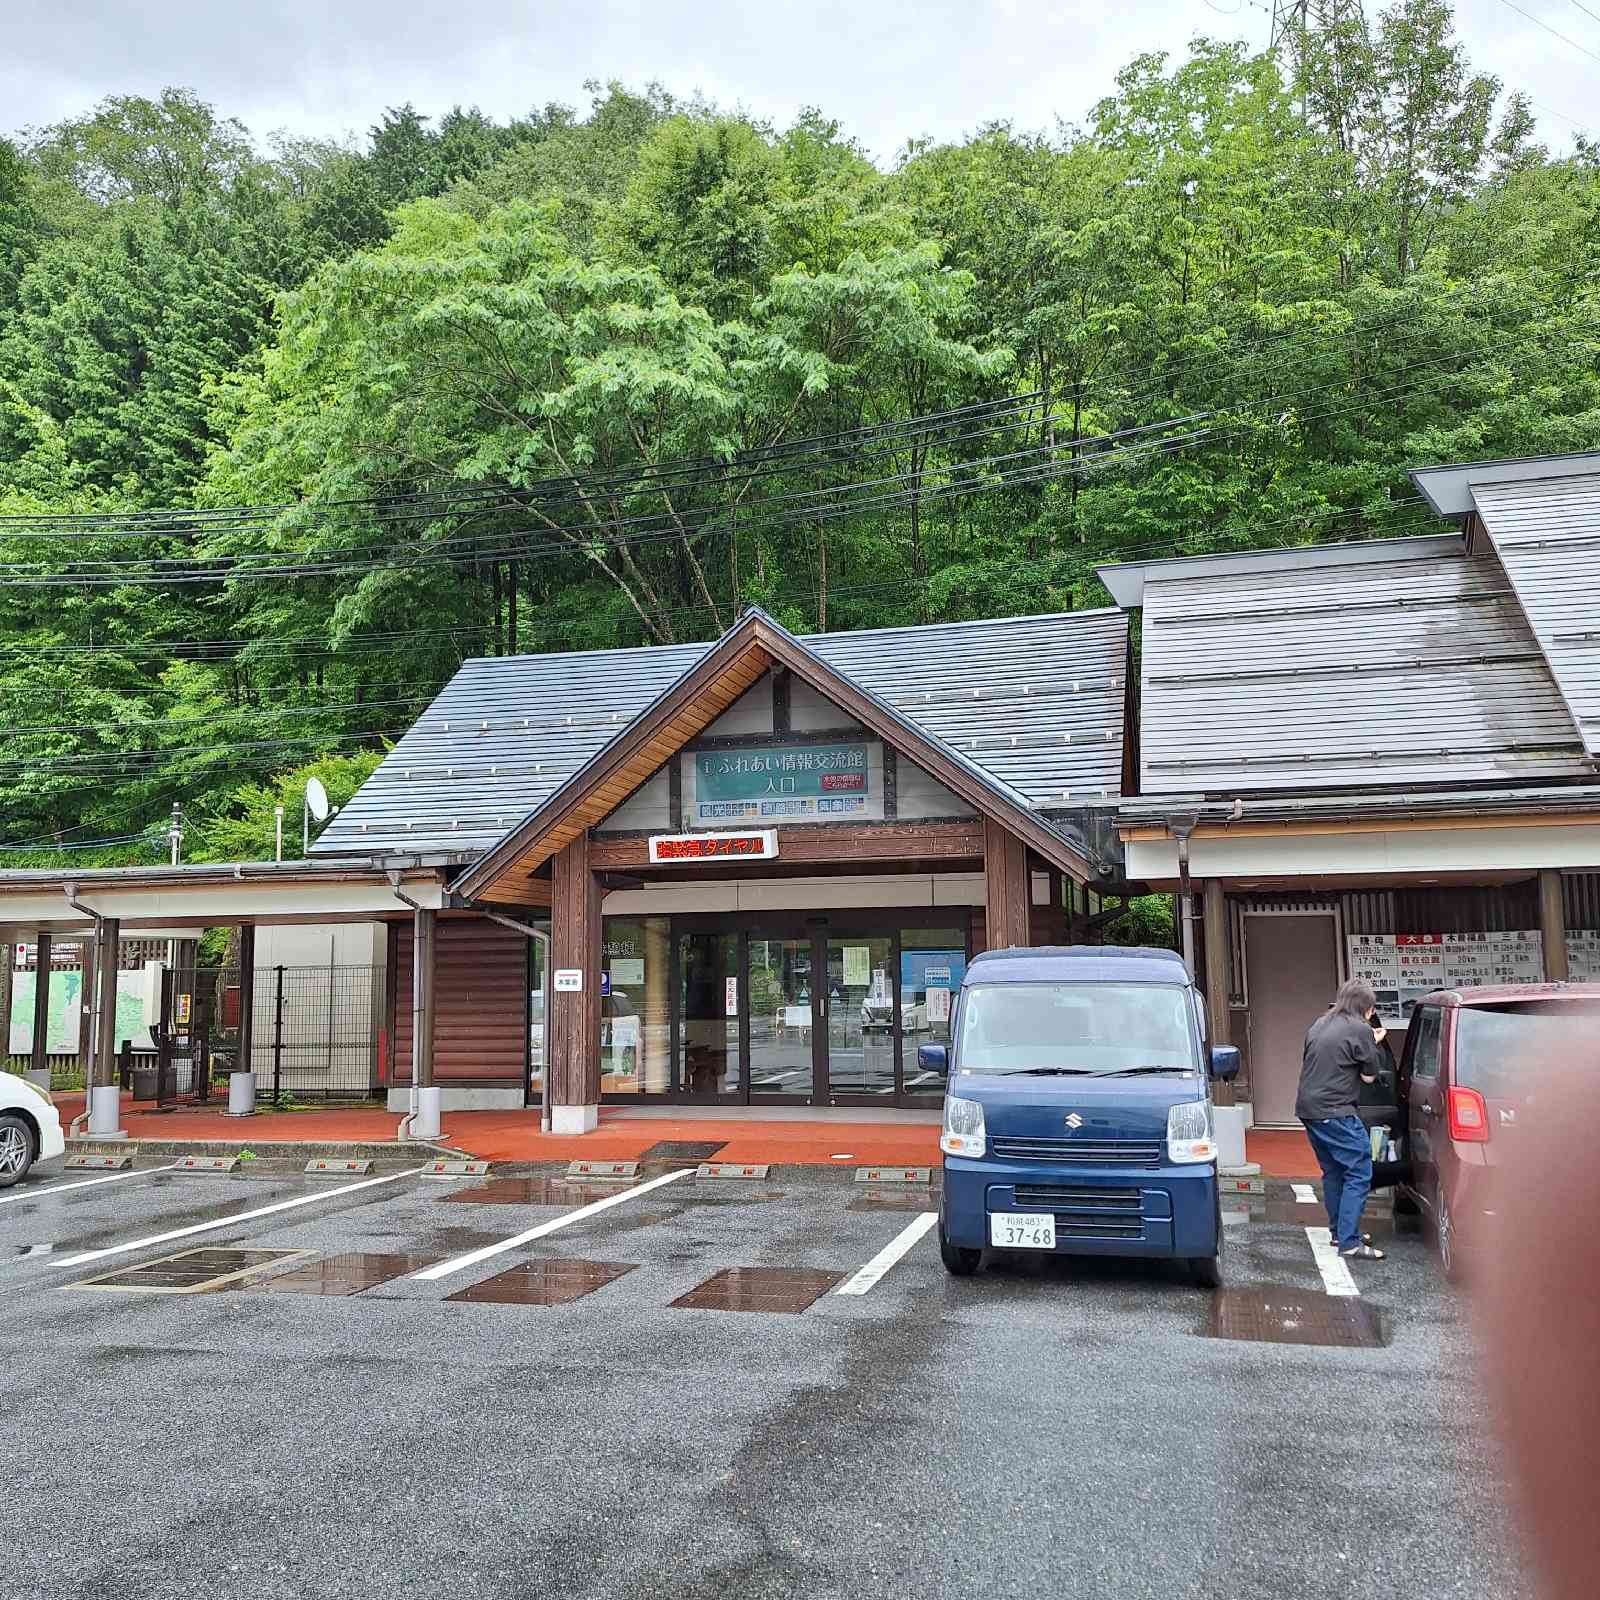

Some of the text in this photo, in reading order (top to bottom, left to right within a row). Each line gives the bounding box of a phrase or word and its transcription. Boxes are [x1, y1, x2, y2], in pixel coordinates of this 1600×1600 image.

[719, 751, 864, 775] ふれあい情報交流館
[1005, 1227, 1052, 1245] 37-68
